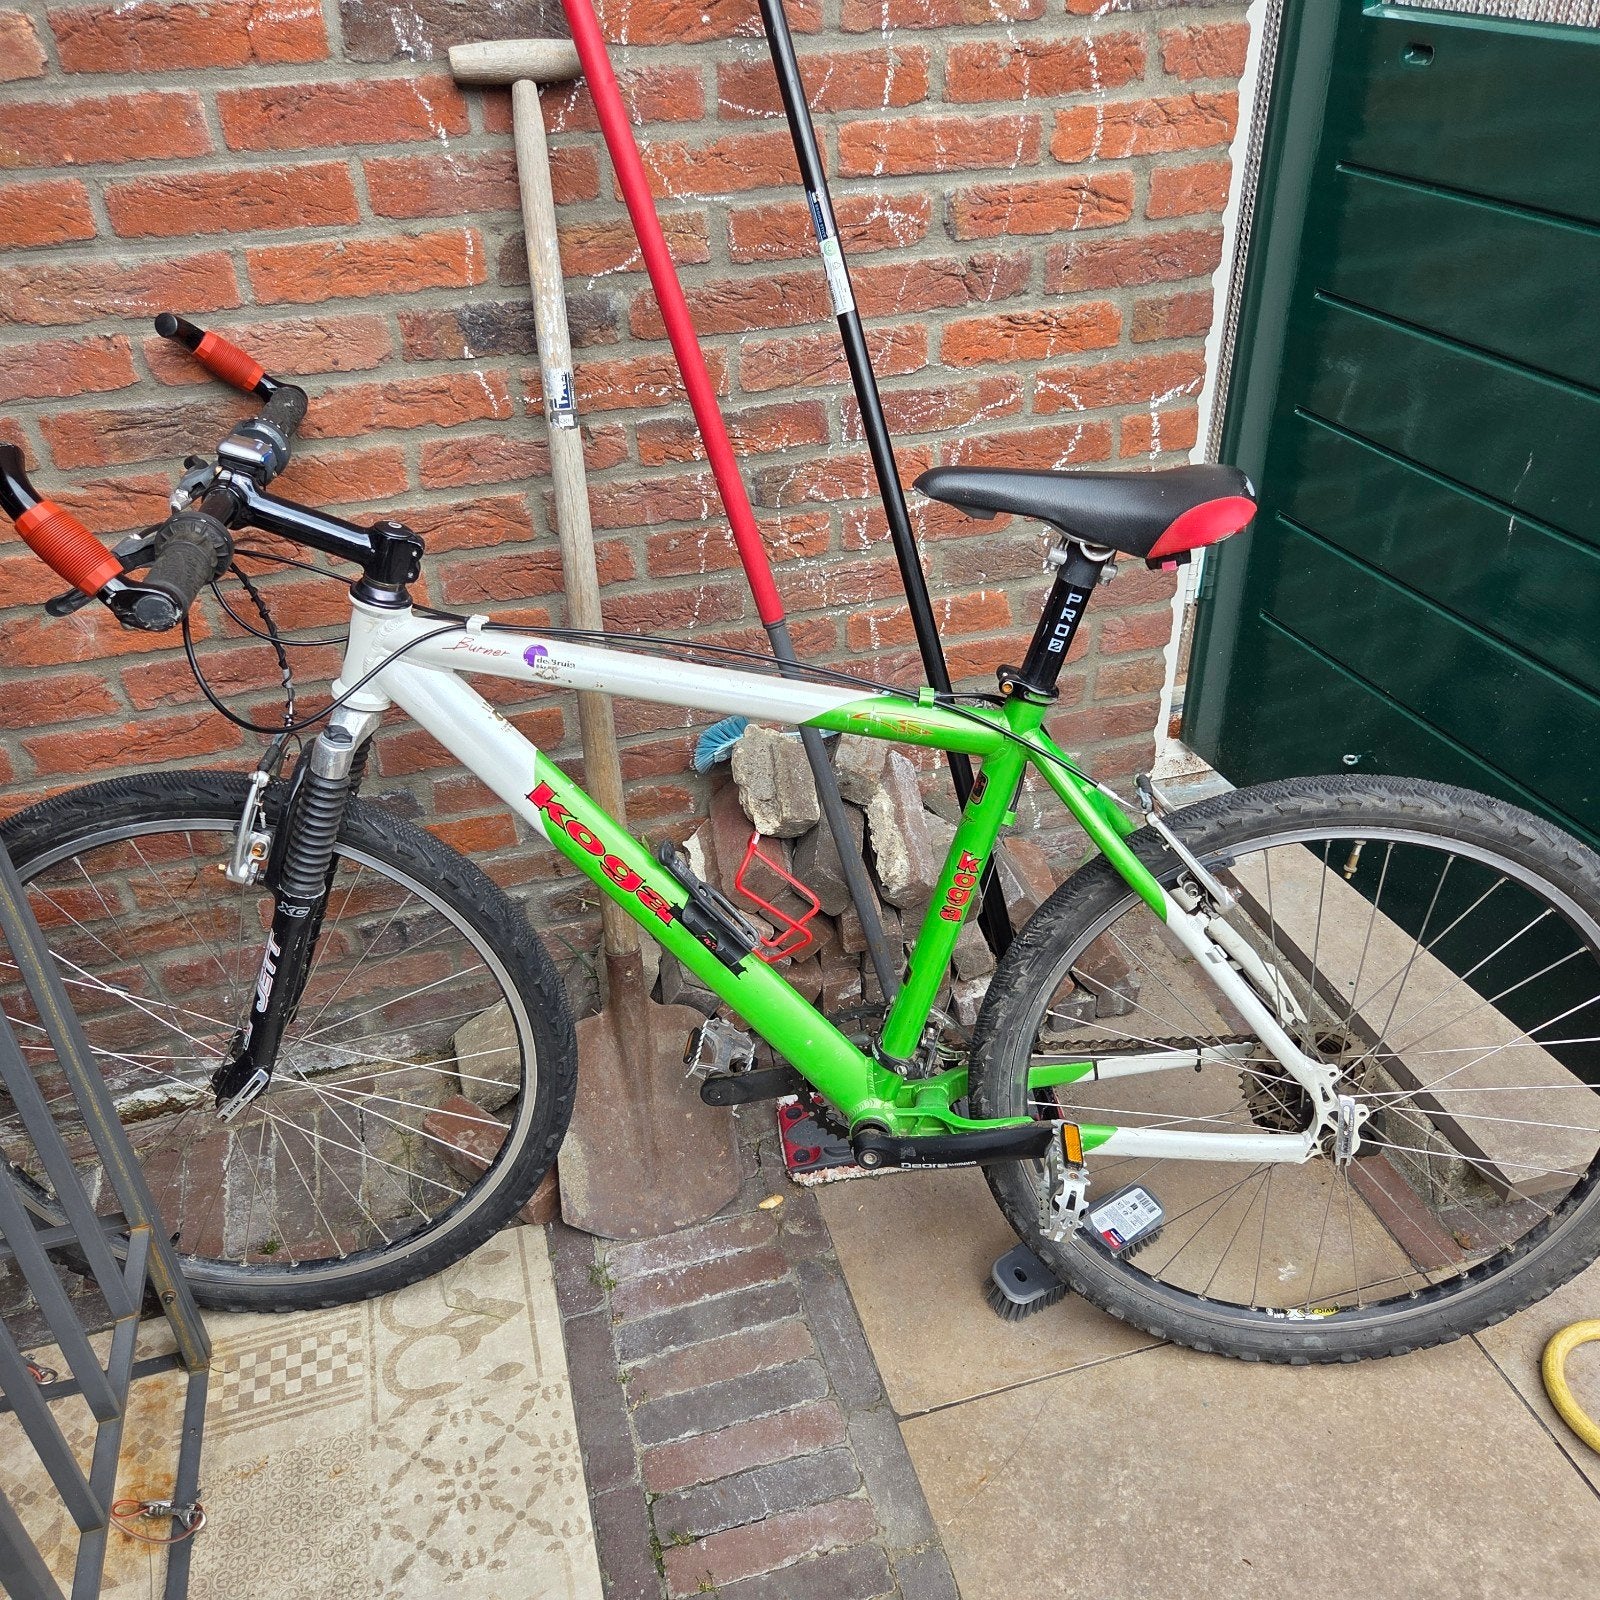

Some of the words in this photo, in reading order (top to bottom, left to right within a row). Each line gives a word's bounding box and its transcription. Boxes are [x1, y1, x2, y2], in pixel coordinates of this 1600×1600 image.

[442, 637, 511, 657] Burner
[278, 901, 310, 918] XC
[256, 928, 281, 1013] JETT
